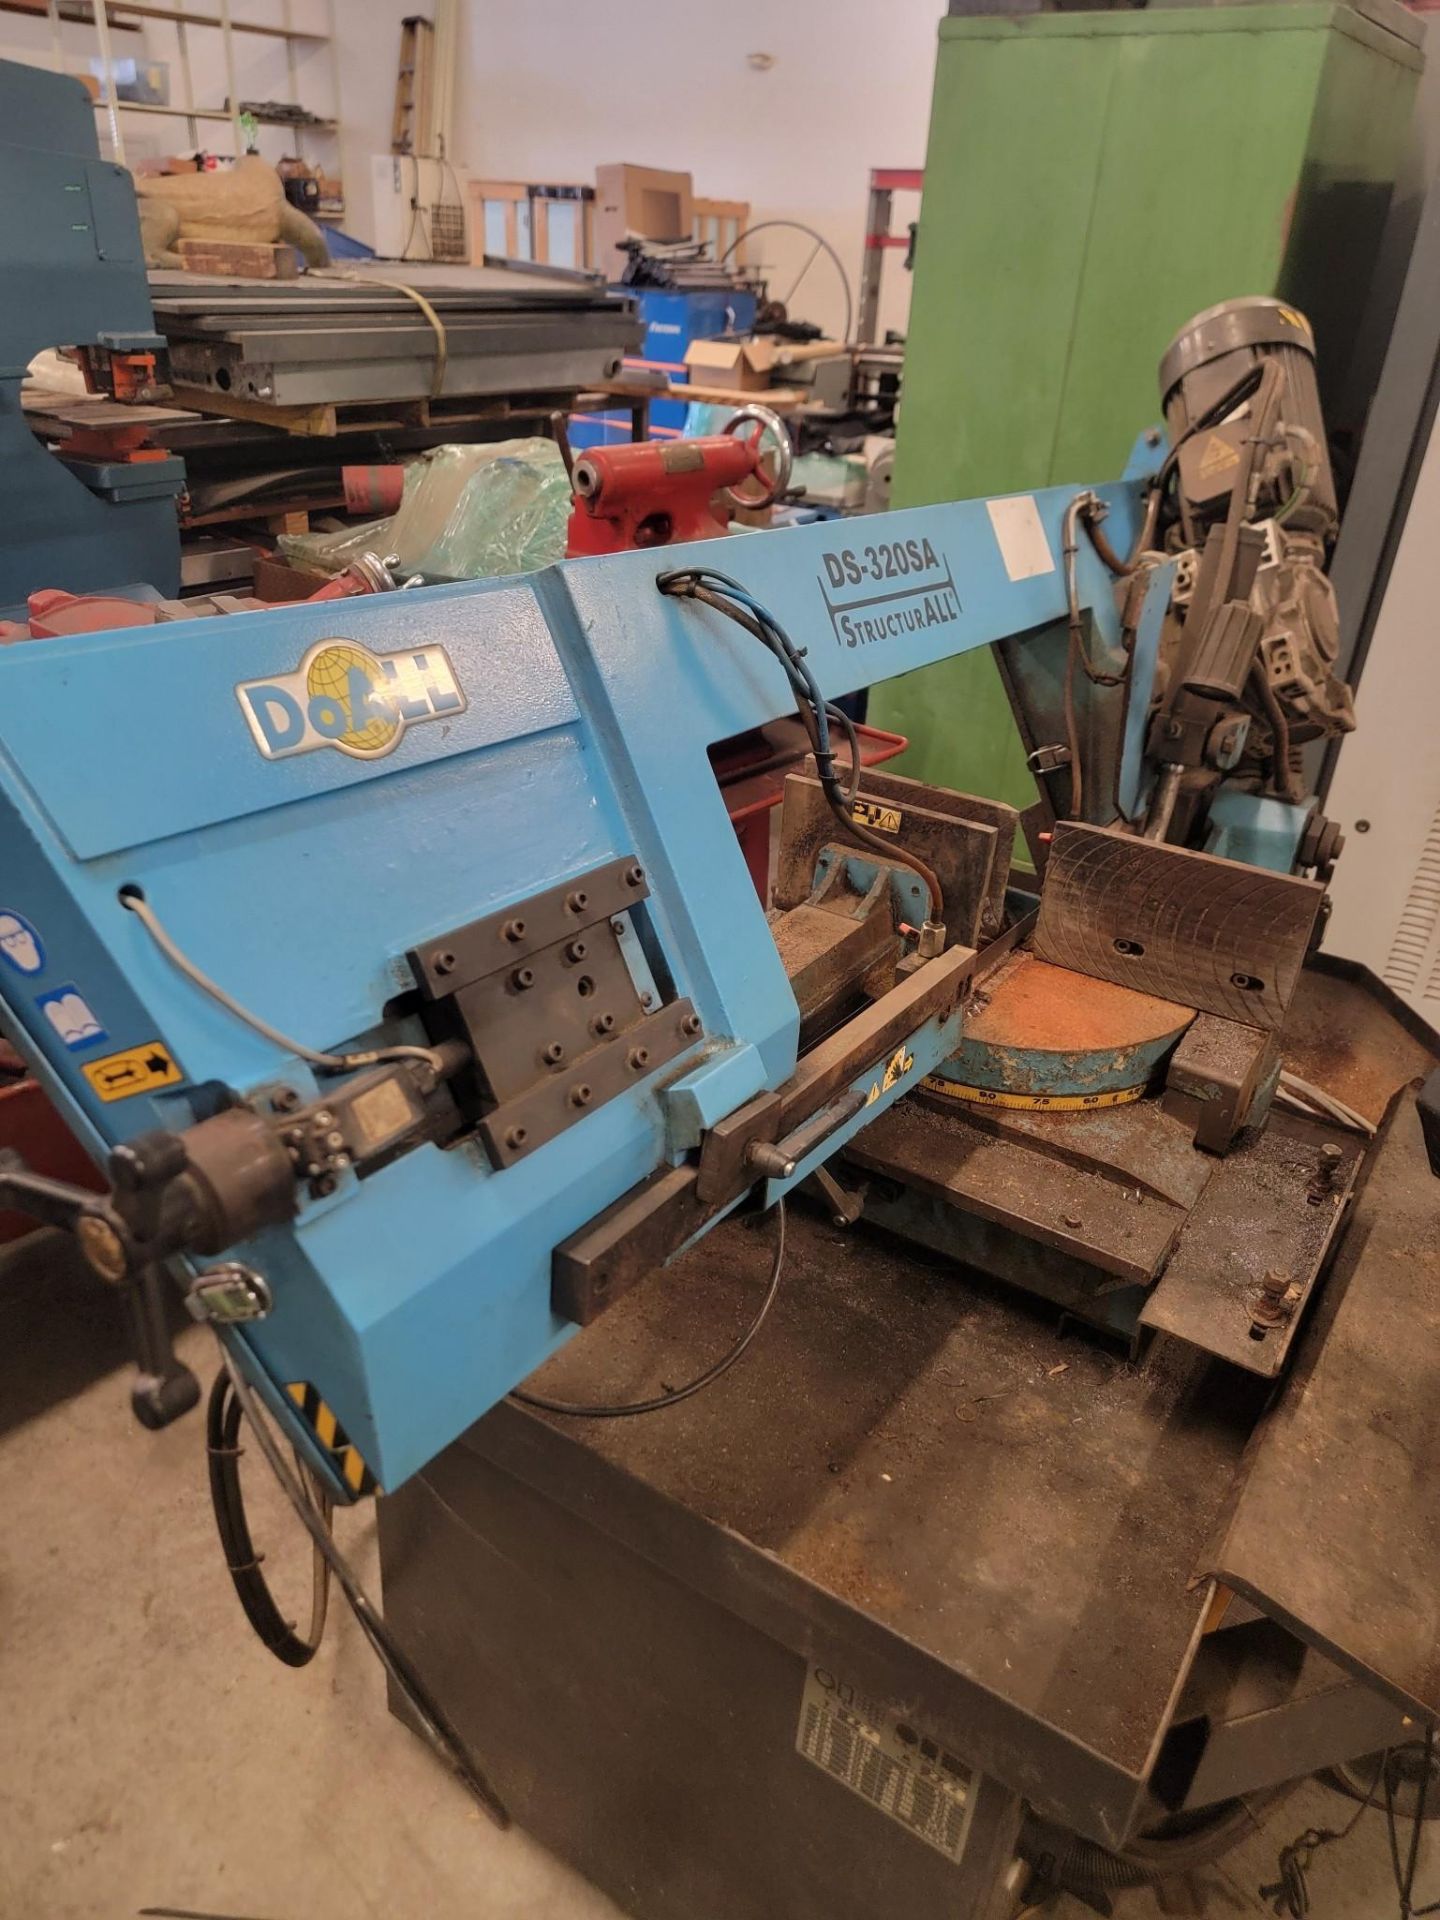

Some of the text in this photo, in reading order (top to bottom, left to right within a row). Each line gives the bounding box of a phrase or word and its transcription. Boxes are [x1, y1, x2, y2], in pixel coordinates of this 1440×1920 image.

[822, 538, 940, 588] DS-320SA
[979, 1091, 997, 1100] 90
[1083, 1096, 1099, 1104] 60
